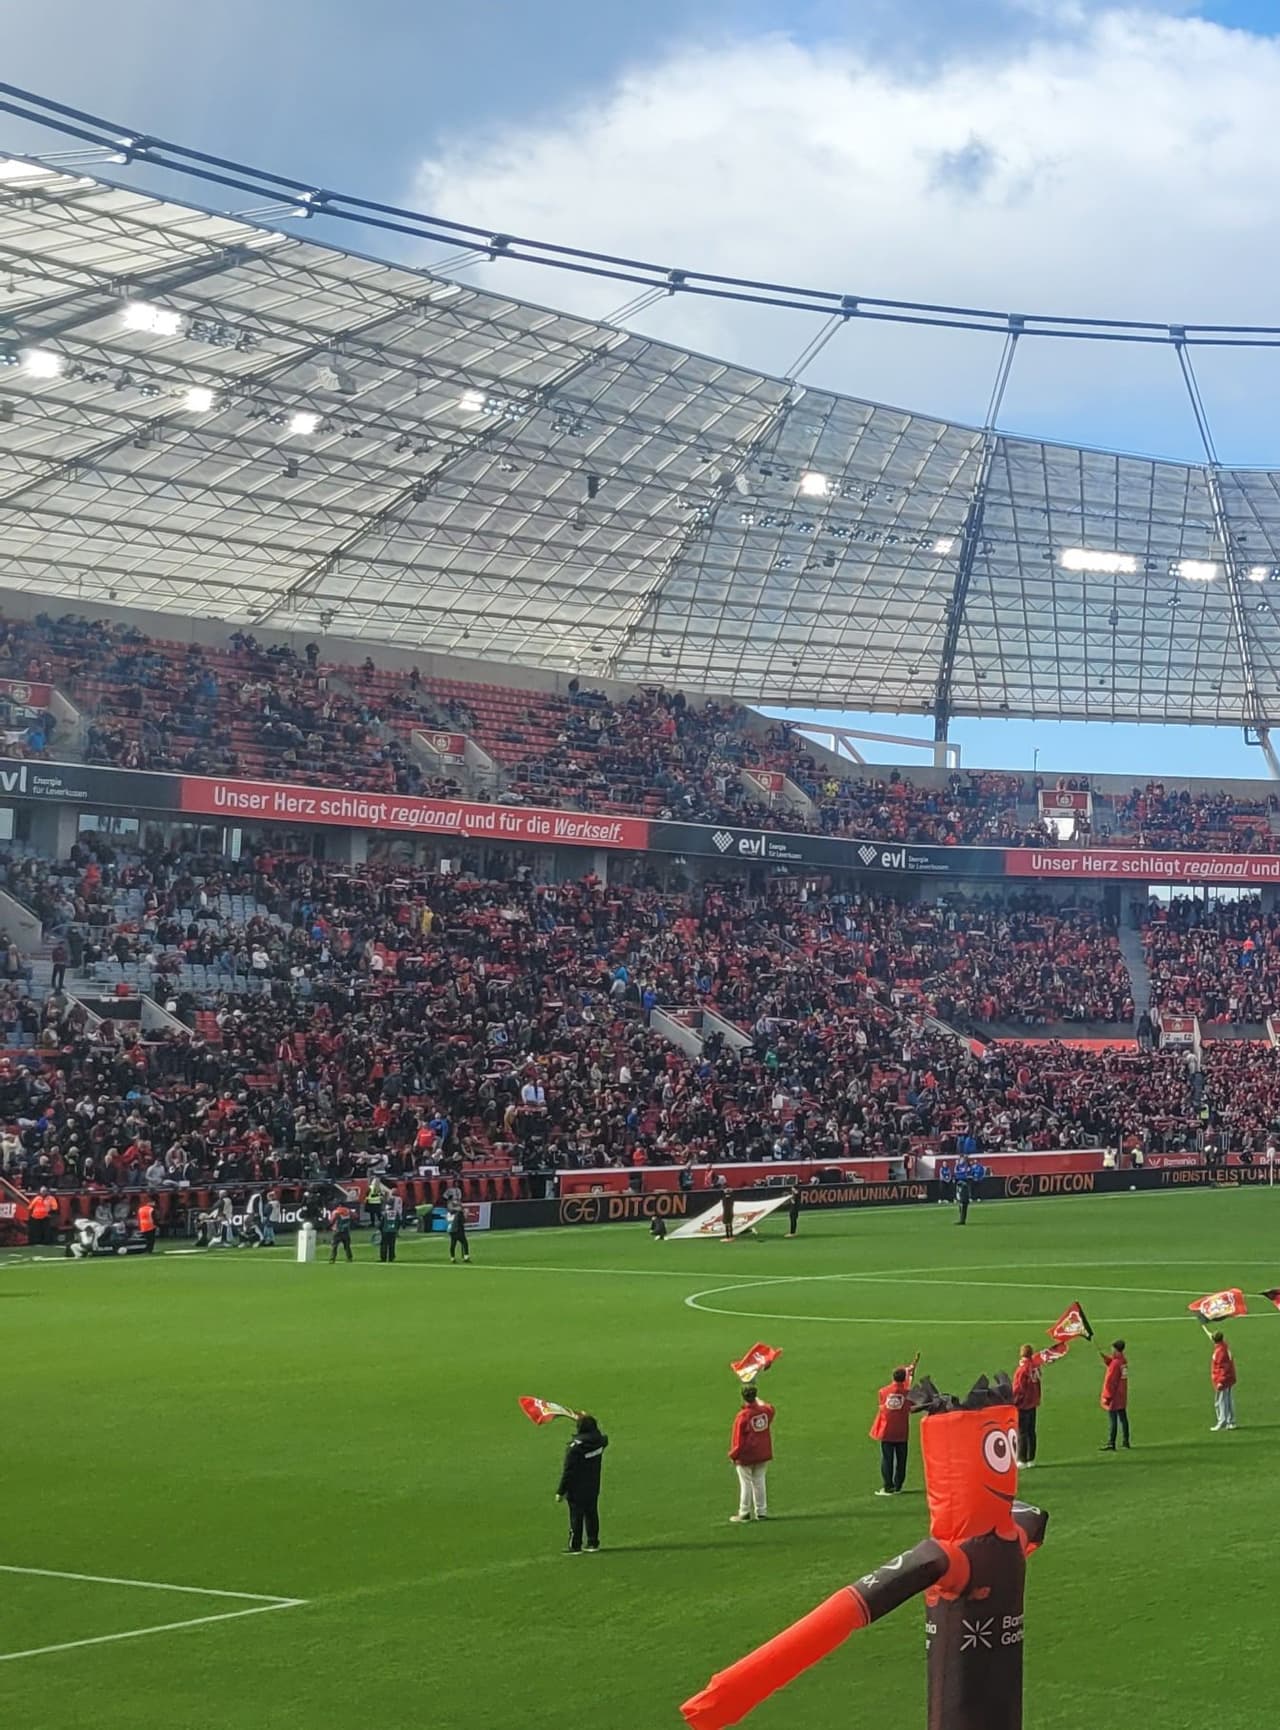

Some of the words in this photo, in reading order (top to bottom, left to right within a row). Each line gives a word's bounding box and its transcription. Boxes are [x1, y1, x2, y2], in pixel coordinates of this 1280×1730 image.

[33, 786, 46, 795] für
[214, 786, 269, 810] Unser
[274, 791, 316, 815] Herz
[320, 797, 387, 823] schlägt
[391, 805, 463, 829] regional
[465, 812, 496, 829] und
[500, 812, 521, 833] für
[527, 815, 550, 834] die
[554, 817, 625, 842] Werkself.
[738, 834, 766, 857] evl
[881, 848, 906, 869] evl
[1032, 854, 1077, 872] Unser
[1082, 856, 1118, 874] Herz
[1122, 857, 1181, 876] schlägt
[1183, 859, 1249, 877] regional
[1252, 861, 1280, 877] und
[1038, 1175, 1095, 1193] DITCON
[1161, 1172, 1170, 1183] IT
[800, 1184, 928, 1205] ROKOMMUNIKATION
[608, 1194, 687, 1219] DITCON
